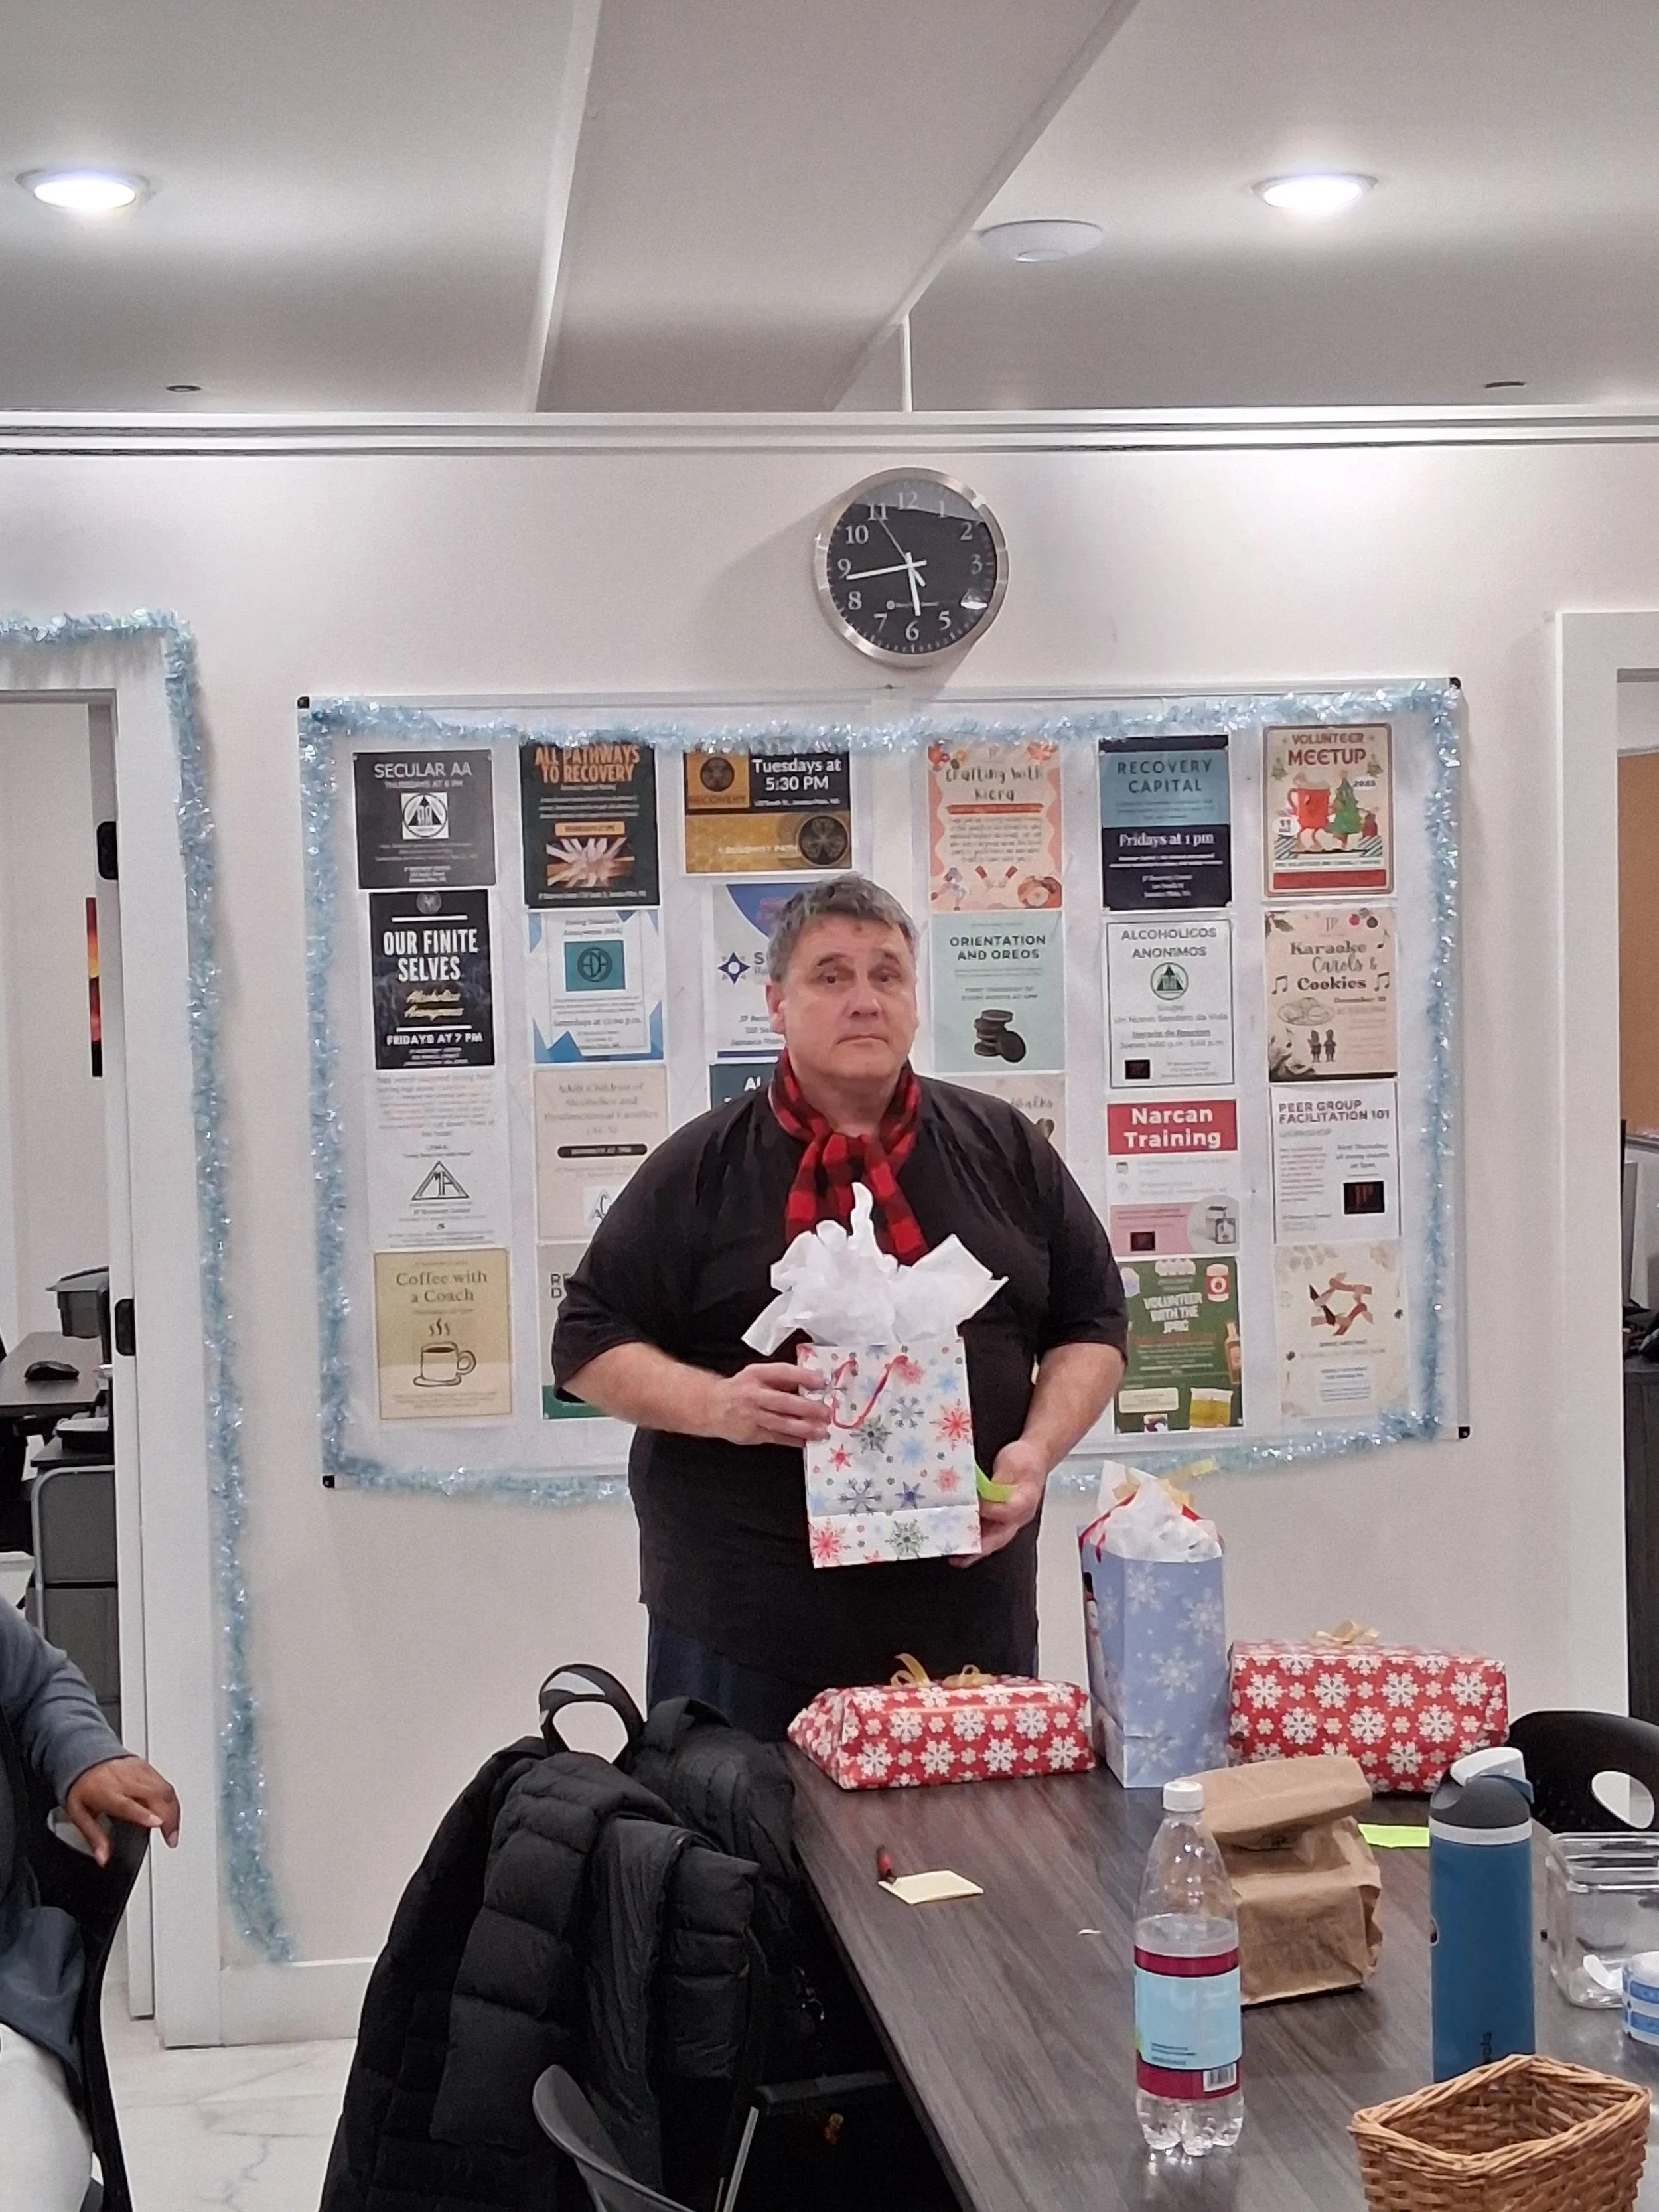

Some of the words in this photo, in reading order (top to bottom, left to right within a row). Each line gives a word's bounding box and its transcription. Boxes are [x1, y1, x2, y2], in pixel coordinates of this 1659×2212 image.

[898, 491, 918, 510] 12
[938, 500, 946, 518] 1
[868, 502, 889, 521] 11
[845, 524, 869, 544] 10
[960, 522, 974, 540] 2
[837, 558, 851, 579] 9
[971, 554, 983, 575] 3
[848, 591, 862, 611] 8
[873, 613, 888, 632] 7
[938, 610, 952, 630] 5
[905, 621, 919, 641] 6
[1292, 733, 1364, 745] VOLUNTEER
[535, 746, 559, 765] ALL
[563, 743, 640, 765] PATHWAYS
[1288, 748, 1366, 766] MEETUP
[374, 762, 446, 778] SECULAR
[450, 761, 472, 776] AA
[541, 765, 560, 784] TO
[564, 764, 635, 783] RECOVERY
[751, 757, 822, 774] Tuesdays
[826, 758, 841, 771] at
[1117, 759, 1212, 774] RECOVERY
[765, 777, 799, 791] 5:30
[803, 775, 829, 790] PM
[1129, 778, 1202, 794] CAPITAL
[1119, 832, 1167, 848] Fridays
[1169, 833, 1182, 845] at
[1193, 834, 1214, 847] pm
[383, 930, 418, 956] OUR
[423, 928, 479, 954] FINITE
[950, 935, 1046, 947] ORIENTATION
[1290, 940, 1367, 955] Karaoke
[957, 950, 987, 961] AND
[991, 949, 1039, 959] OREOS
[1312, 954, 1363, 973] Carols
[398, 956, 461, 982] SELVES
[1297, 976, 1366, 991] Cookies
[386, 1034, 435, 1045] FRIDAYS
[437, 1033, 453, 1044] AT
[454, 1033, 463, 1043] 7
[464, 1032, 484, 1043] PM
[1278, 1102, 1313, 1112] PEER
[1317, 1100, 1362, 1111] GROUP
[1131, 1108, 1213, 1125] Narcan
[1279, 1111, 1368, 1124] FACILITATION
[1371, 1110, 1390, 1119] 101
[1123, 1128, 1221, 1149] Training
[396, 1272, 449, 1286] Coffee
[453, 1270, 488, 1284] with
[410, 1293, 419, 1303] a
[424, 1288, 474, 1302] Coach
